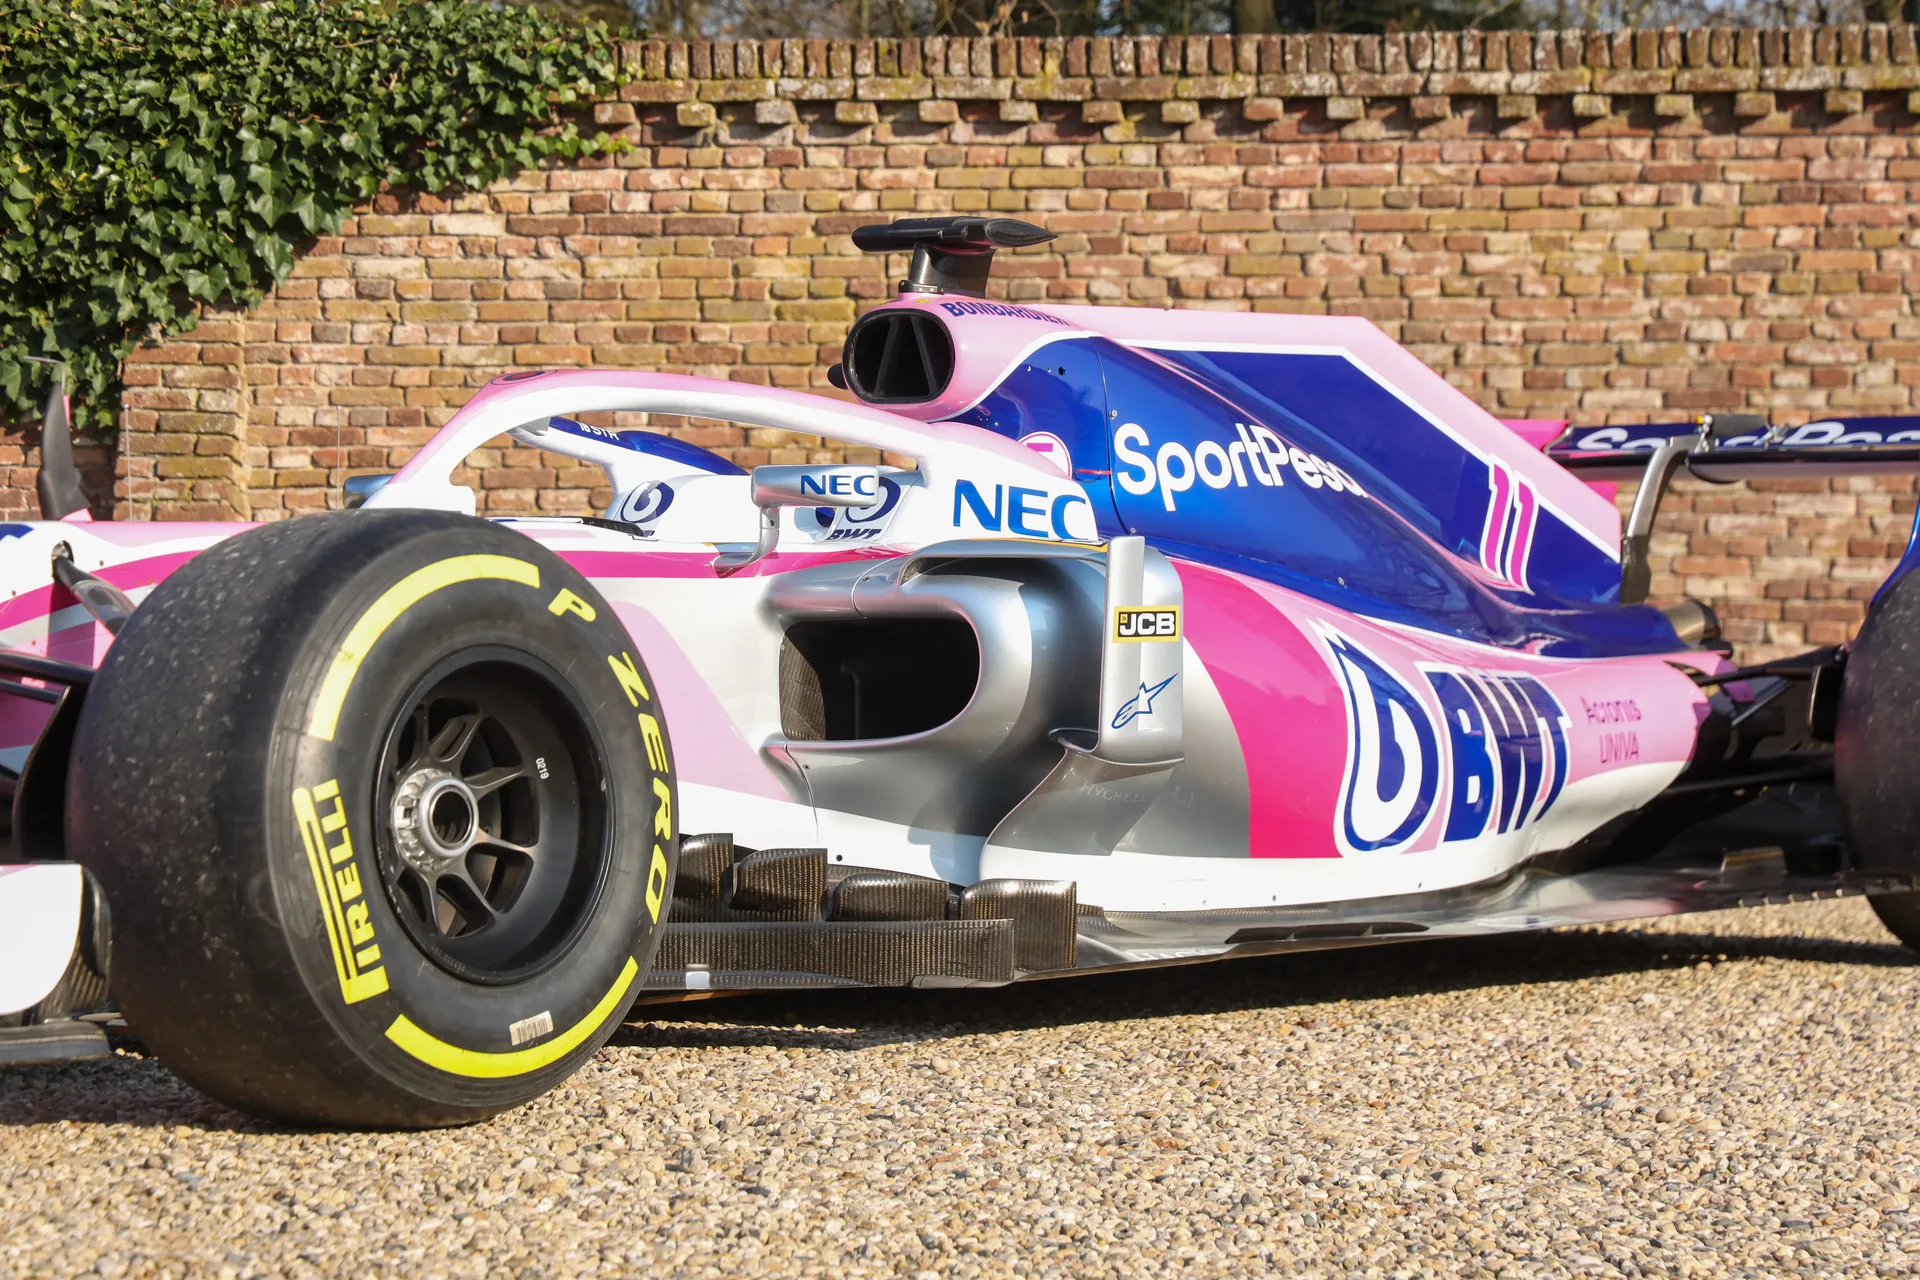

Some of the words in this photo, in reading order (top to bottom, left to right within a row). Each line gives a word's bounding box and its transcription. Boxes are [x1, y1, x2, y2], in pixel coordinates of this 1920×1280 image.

[801, 474, 875, 496] NEC
[1114, 422, 1368, 512] SportPesa
[825, 529, 882, 541] BWT
[953, 479, 1088, 541] NEC
[1481, 454, 1538, 593] 11
[1119, 612, 1175, 636] JCB
[1580, 695, 1642, 724] Acronis
[535, 757, 550, 780] 0219
[547, 588, 597, 622] P
[607, 651, 673, 925] ZERO
[1421, 669, 1568, 844] BWT
[292, 778, 390, 1005] PIRELLI
